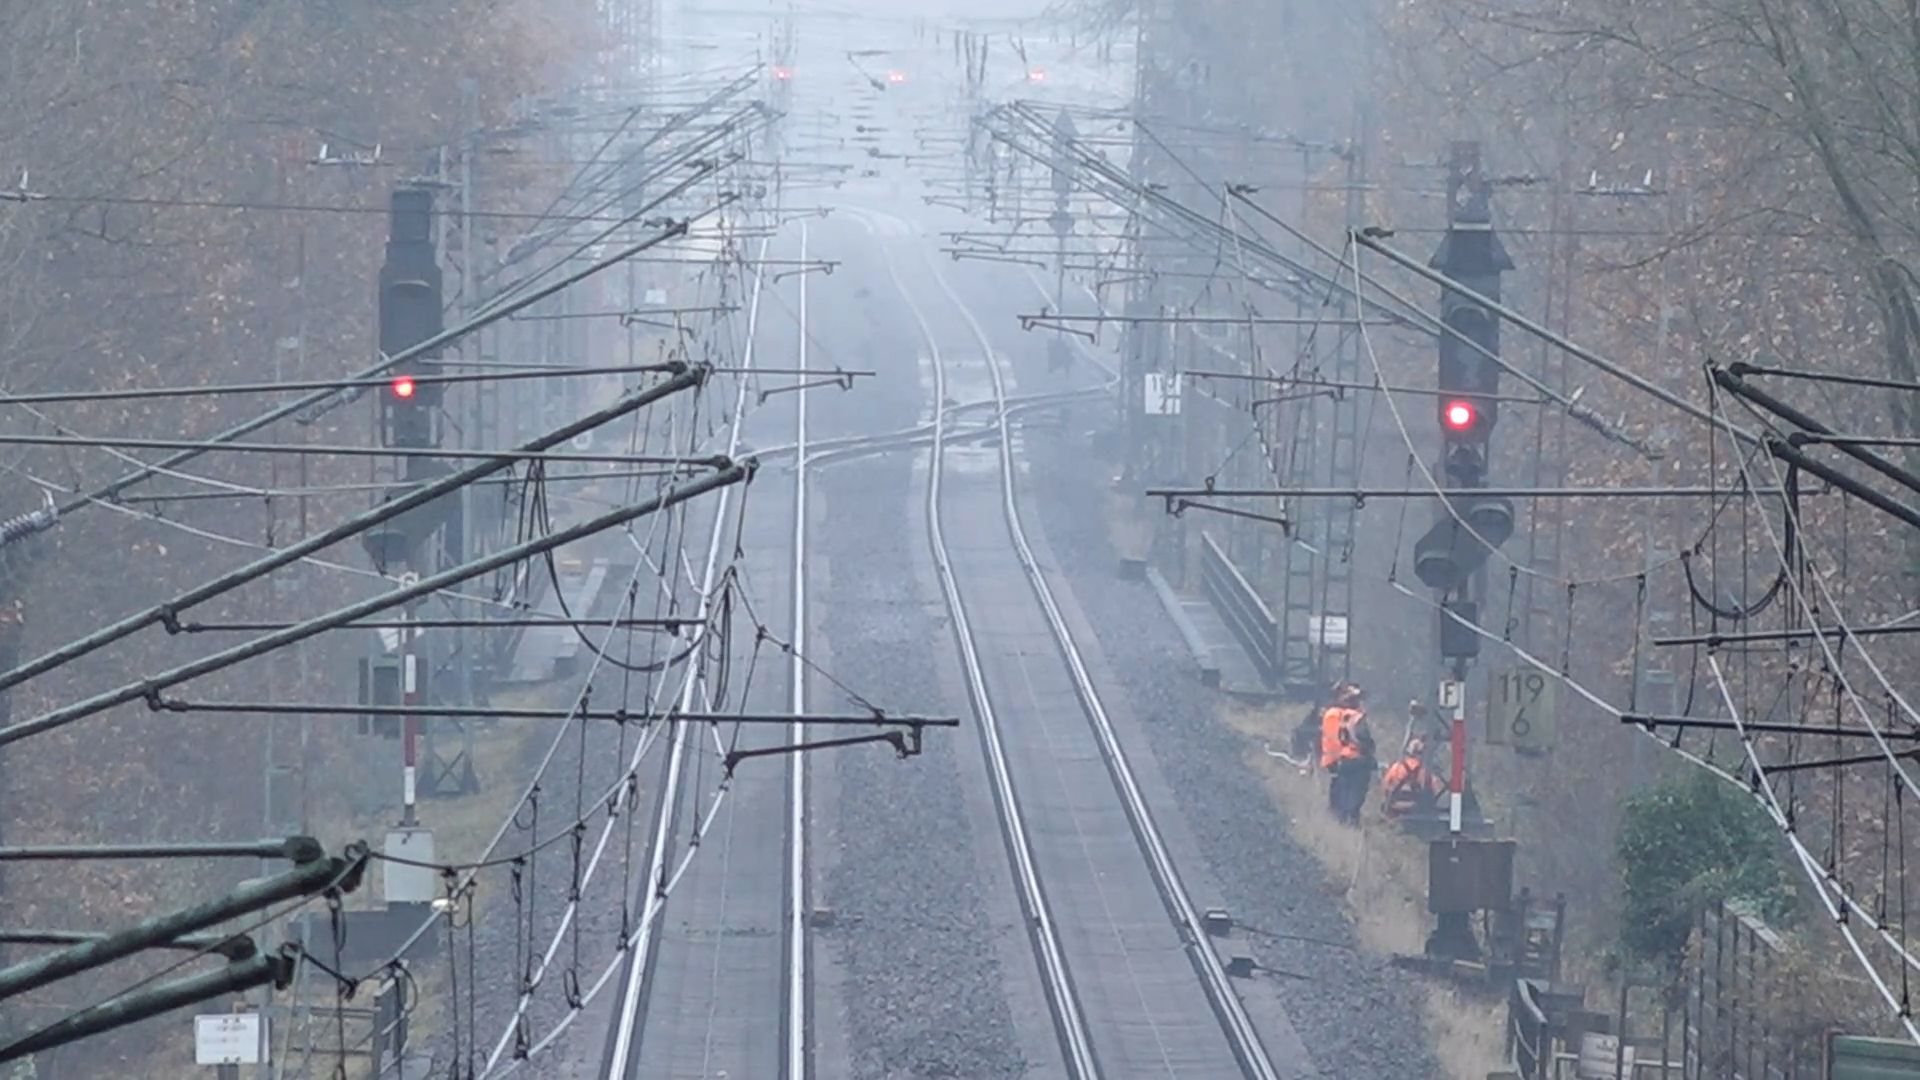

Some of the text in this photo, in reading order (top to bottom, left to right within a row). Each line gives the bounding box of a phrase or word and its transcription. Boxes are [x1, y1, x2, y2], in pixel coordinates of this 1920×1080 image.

[1444, 682, 1455, 705] F
[1500, 674, 1544, 702] 119
[1511, 707, 1530, 737] 6
